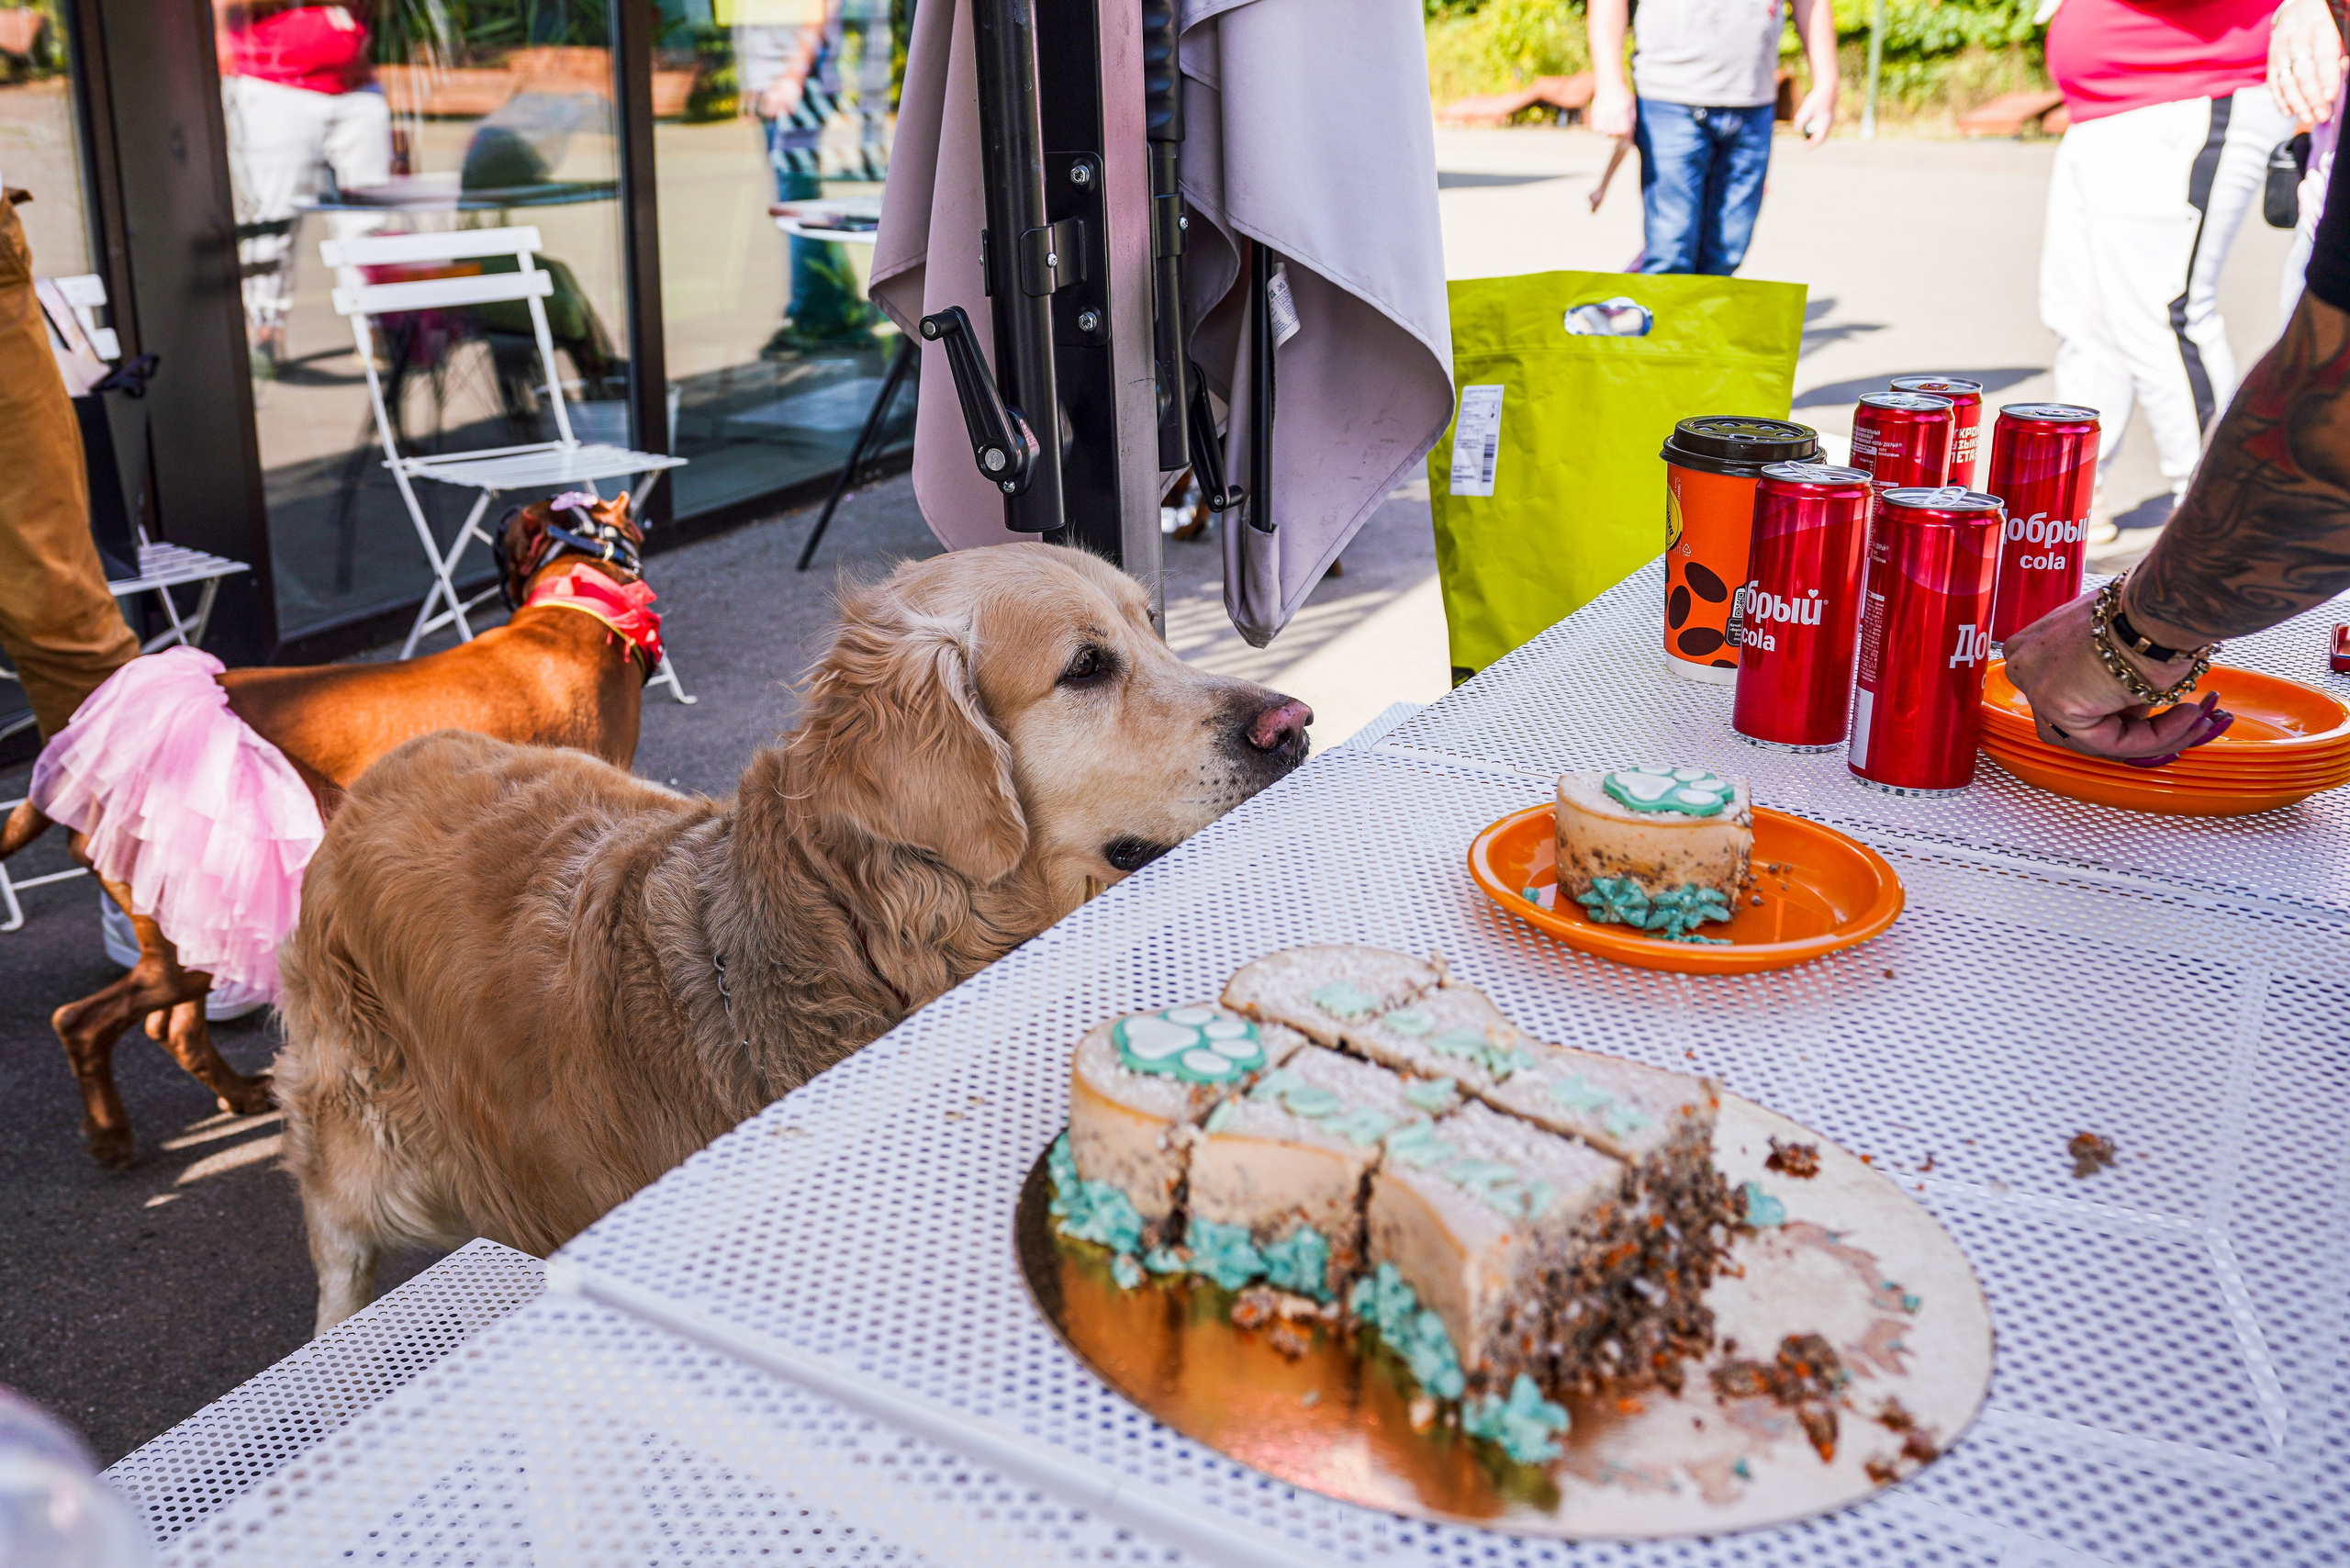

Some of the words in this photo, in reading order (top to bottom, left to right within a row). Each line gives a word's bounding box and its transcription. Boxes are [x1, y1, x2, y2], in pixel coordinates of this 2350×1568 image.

[2020, 552, 2066, 570] cola
[1745, 580, 1823, 626] брый
[1741, 627, 1775, 652] cola
